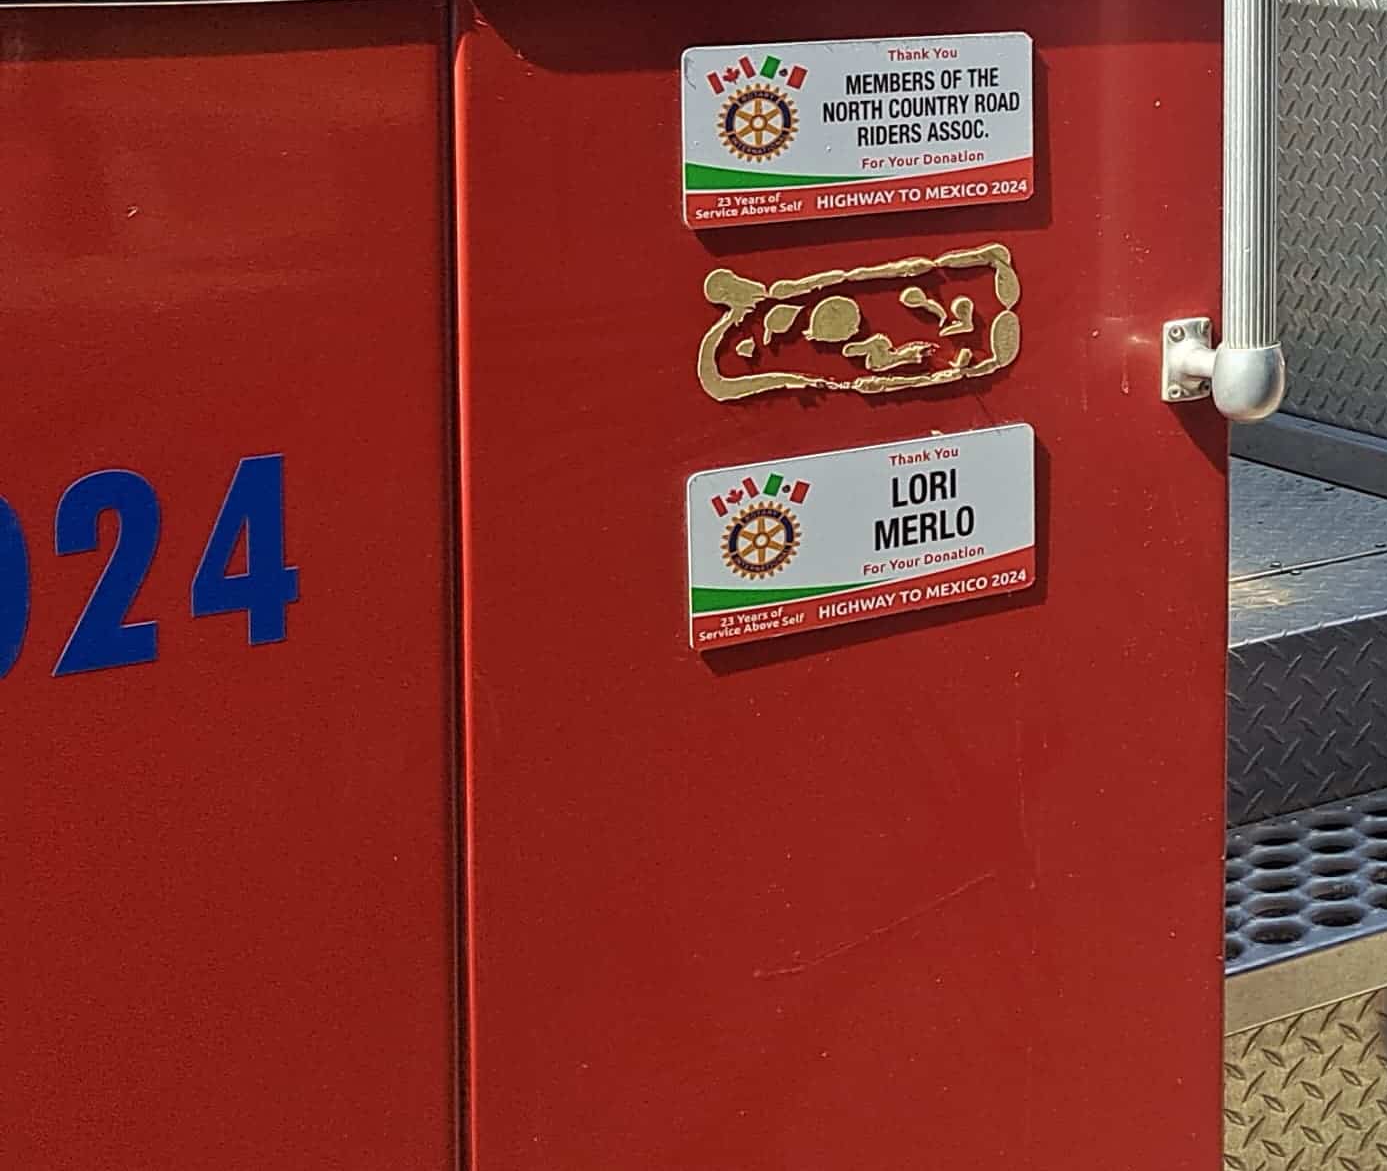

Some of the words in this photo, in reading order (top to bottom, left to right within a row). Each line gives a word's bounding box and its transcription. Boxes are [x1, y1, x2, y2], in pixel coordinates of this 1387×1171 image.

[888, 49, 930, 61] Thank
[933, 48, 957, 59] You
[846, 71, 936, 94] MEMBERS
[941, 70, 963, 88] OF
[967, 68, 999, 86] THE
[823, 100, 883, 123] NORTH
[888, 96, 969, 118] COUNTRY
[975, 92, 1019, 112] ROAD
[858, 123, 921, 146] RIDERS
[927, 120, 989, 142] ASSOC.
[861, 158, 884, 169] For
[888, 155, 919, 167] Your
[923, 151, 984, 165] Donation
[718, 197, 731, 206] 23
[735, 195, 765, 205] Years
[768, 193, 781, 204] of
[817, 191, 895, 209] HIGHWAY
[899, 188, 921, 202] TO
[925, 184, 988, 200] MEXICO
[992, 180, 1027, 194] 2024
[696, 208, 738, 219] Service
[741, 204, 776, 215] Above
[779, 201, 802, 212] Self
[889, 450, 931, 467] Thank
[934, 447, 959, 459] You
[892, 469, 956, 507] LORI
[874, 506, 975, 551] MERLO
[863, 564, 886, 576] For
[889, 557, 921, 571] Your
[924, 546, 984, 565] Donation
[818, 594, 896, 618] HIGHWAY
[899, 589, 921, 603] TO
[926, 577, 988, 599] MEXICO
[992, 568, 1026, 586] 2024
[699, 626, 741, 641] Service
[744, 619, 780, 633] Above
[782, 613, 805, 627] Self
[720, 617, 734, 627] 23
[738, 612, 769, 624] Years
[771, 607, 784, 619] of
